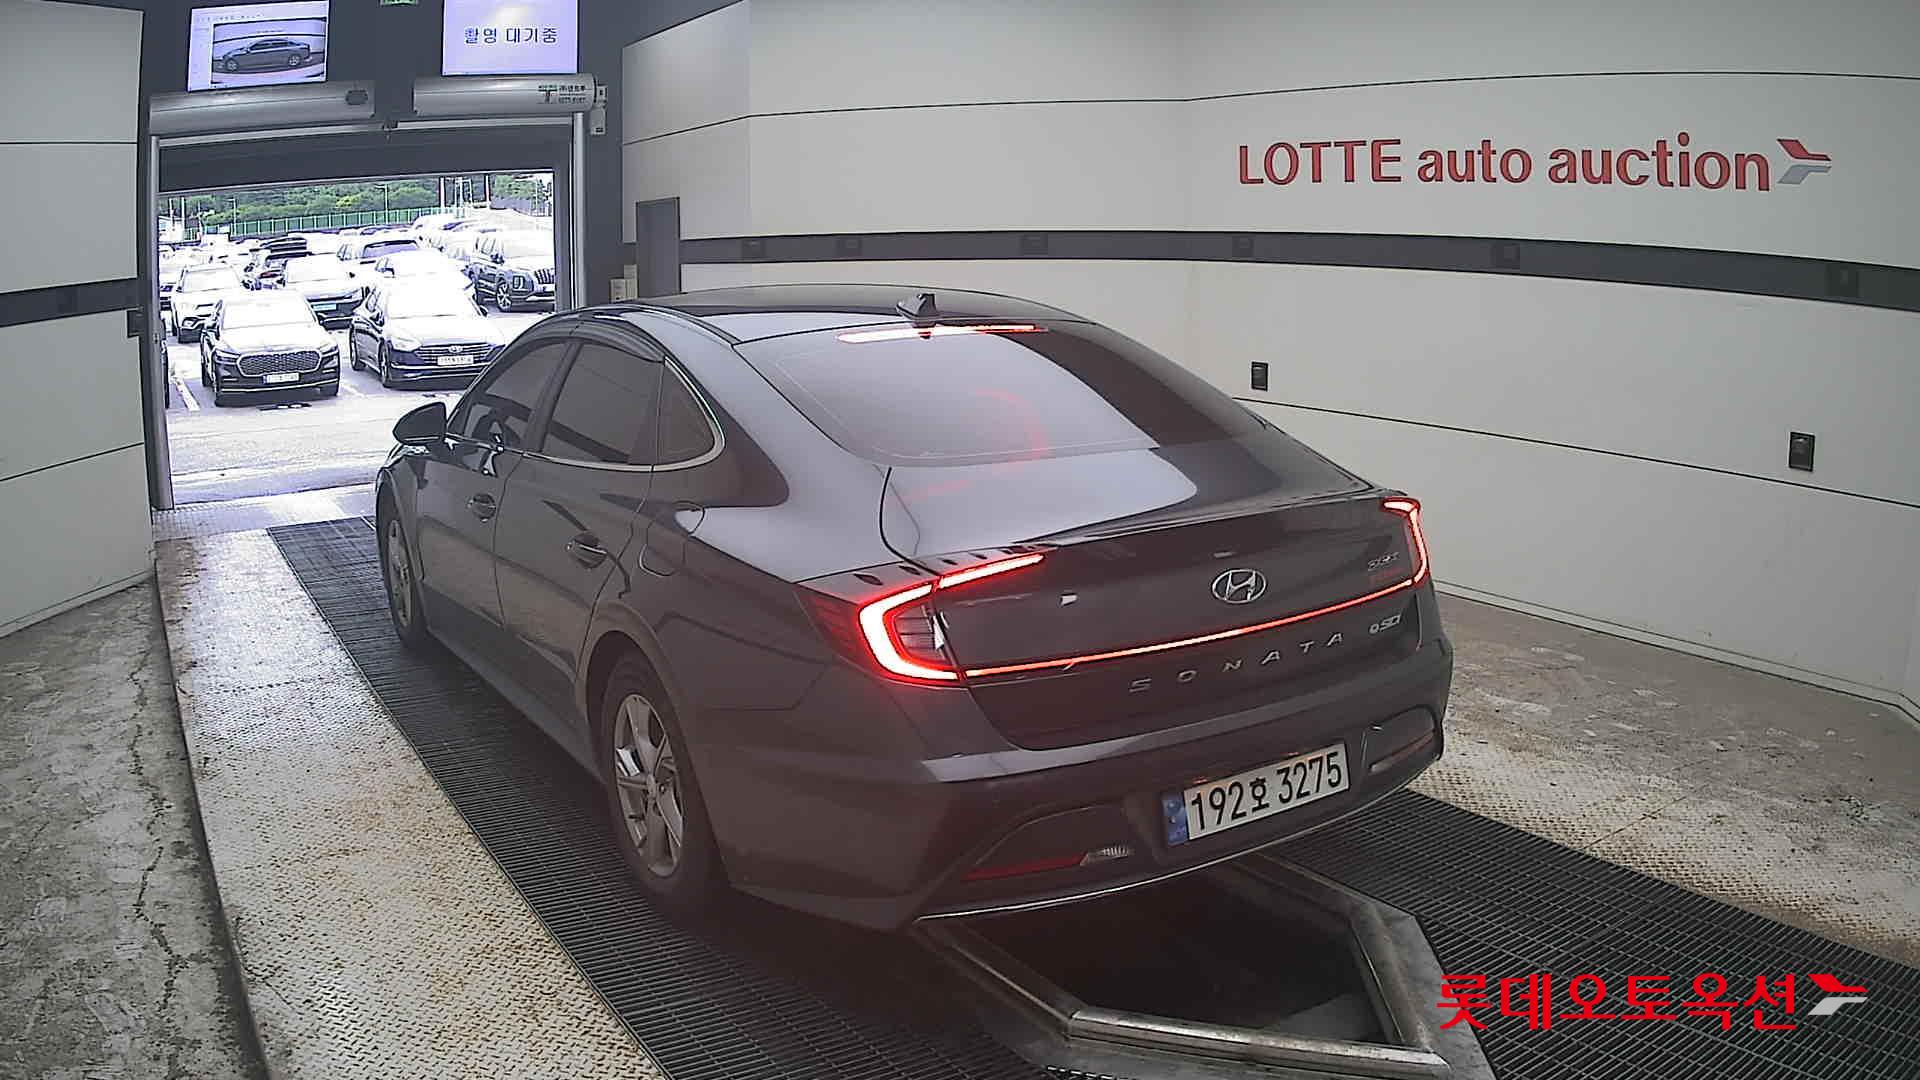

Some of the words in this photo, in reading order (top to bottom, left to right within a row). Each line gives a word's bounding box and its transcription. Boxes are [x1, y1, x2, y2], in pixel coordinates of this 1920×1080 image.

[506, 27, 557, 44] 대기중
[1239, 138, 1401, 185] LOTTE
[1417, 139, 1532, 183] auto
[1549, 131, 1770, 191] auction
[1129, 633, 1344, 693] SONATA
[1276, 751, 1342, 804] 3275
